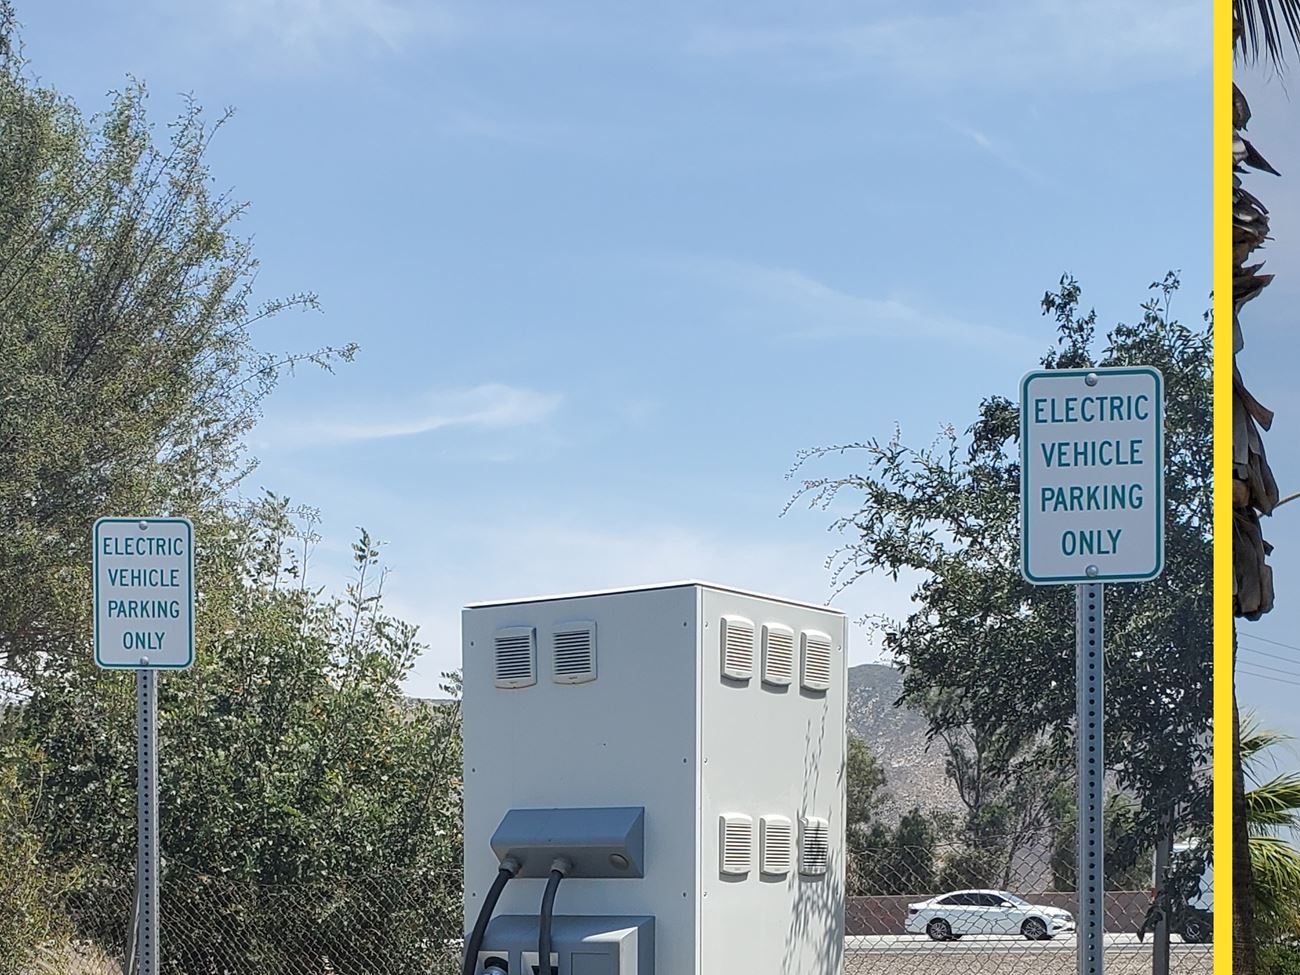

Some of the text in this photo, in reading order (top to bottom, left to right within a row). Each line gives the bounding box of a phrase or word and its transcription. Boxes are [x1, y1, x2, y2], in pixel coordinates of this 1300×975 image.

[1034, 394, 1149, 424] ELECTRIC
[1040, 439, 1144, 468] VEHICLE
[1041, 483, 1144, 512] PARKING
[103, 537, 184, 556] ELECTRIC
[1061, 528, 1122, 556] ONLY
[107, 568, 180, 587] VEHICLE
[108, 600, 180, 619] PARKING
[122, 631, 166, 650] ONLY
